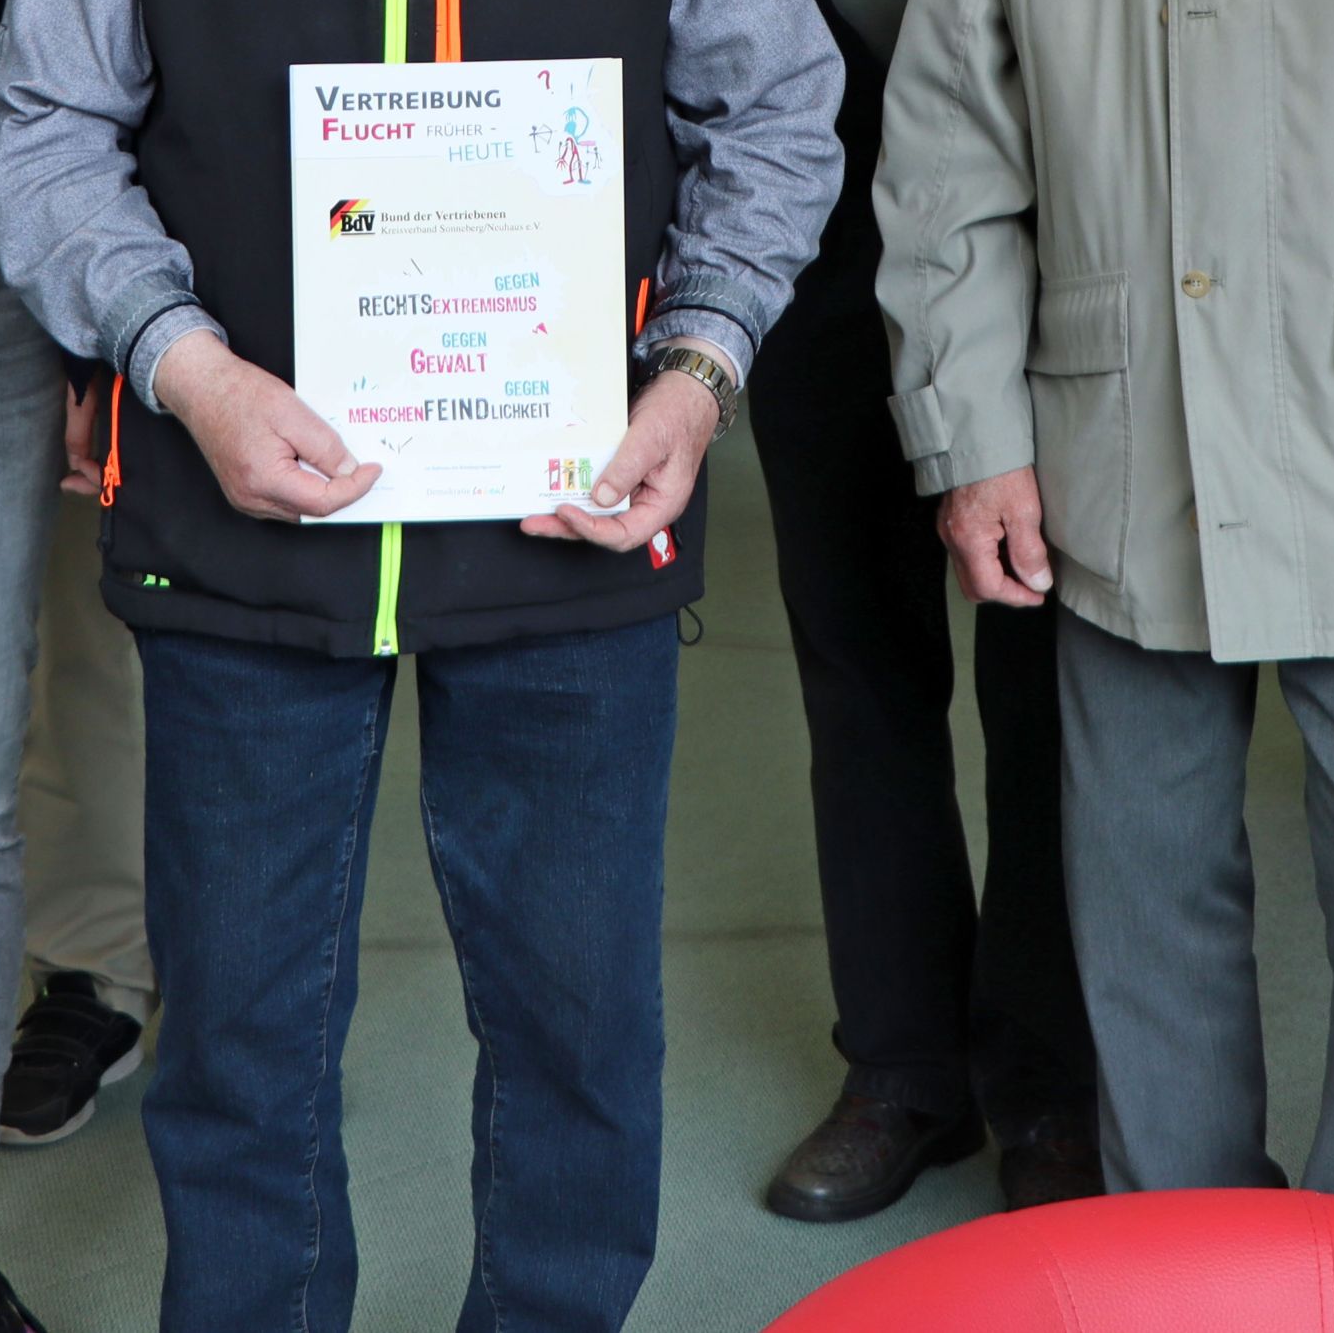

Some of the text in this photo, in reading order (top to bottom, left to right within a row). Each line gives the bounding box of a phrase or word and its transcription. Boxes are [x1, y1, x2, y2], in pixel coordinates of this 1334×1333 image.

[315, 85, 502, 111] VERTREIBUNG
[322, 118, 416, 141] FLUCHT
[426, 121, 484, 138] FRÜHER
[448, 141, 515, 163] HEUTE
[340, 212, 376, 233] BdV
[380, 210, 507, 223] Bund der Vertriebenen
[380, 223, 438, 235] Kreisverband
[439, 221, 524, 234] Sonneberg/Neuhaus
[494, 272, 540, 292] GEGEN
[358, 293, 537, 317] RECHTSEXTREMISMUS
[441, 331, 487, 348] GEGEN
[410, 348, 487, 374] GEWALT
[504, 380, 550, 396] GEGEN
[348, 397, 552, 424] MENSCHENFEINDLICHKEIT
